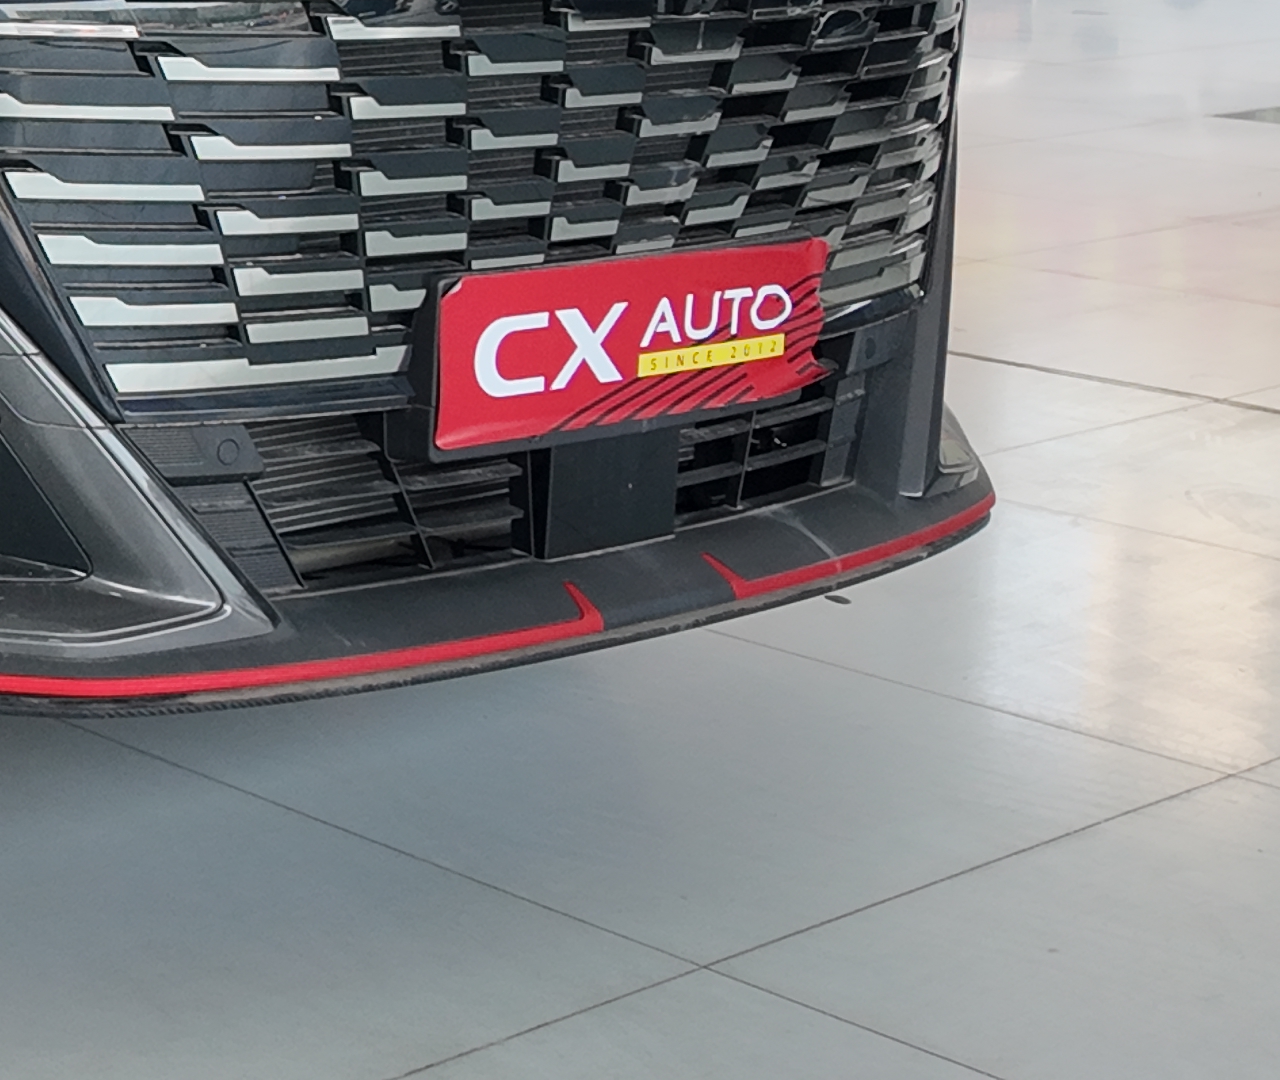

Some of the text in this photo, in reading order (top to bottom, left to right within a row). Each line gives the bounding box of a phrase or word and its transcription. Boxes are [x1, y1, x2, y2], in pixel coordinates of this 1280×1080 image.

[474, 284, 793, 398] CX AUTO
[650, 339, 778, 372] SINCE 2012
